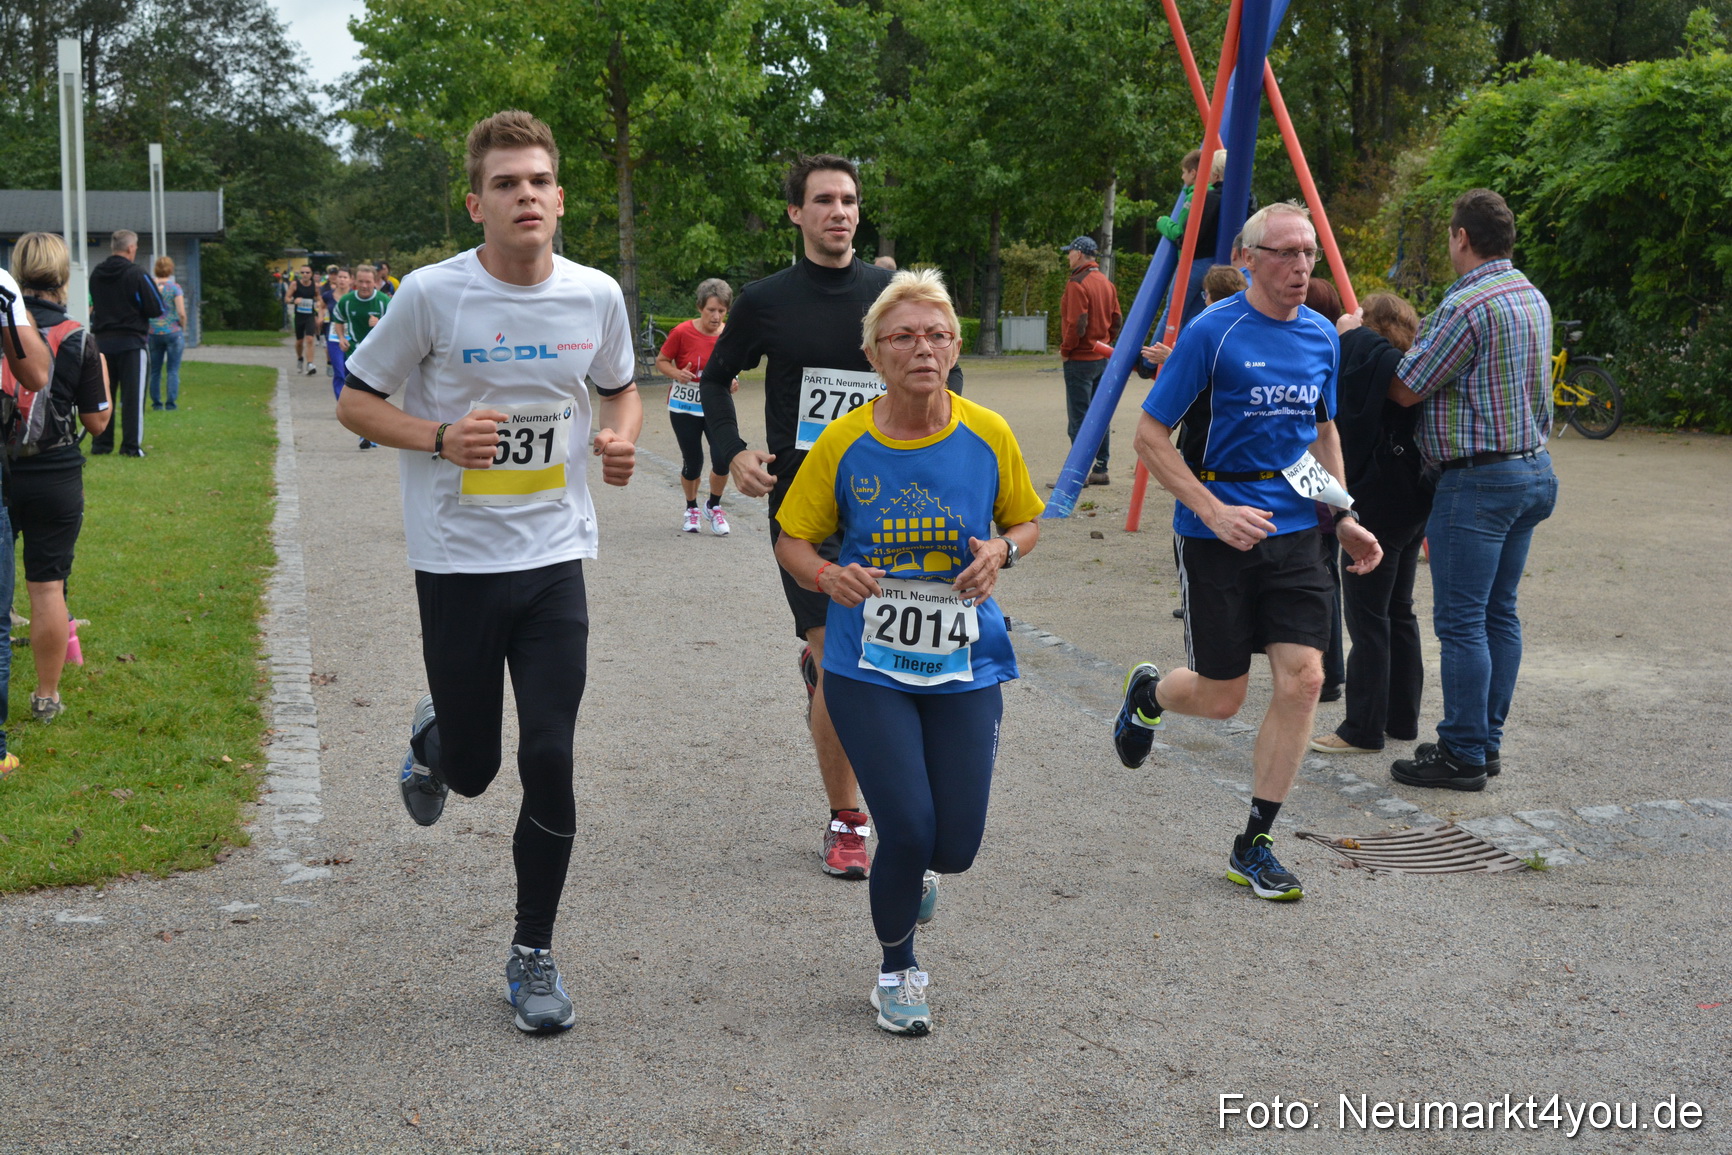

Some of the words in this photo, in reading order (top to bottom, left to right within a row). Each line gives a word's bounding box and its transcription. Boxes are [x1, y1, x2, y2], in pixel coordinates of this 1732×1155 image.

[557, 339, 593, 350] energie
[804, 375, 834, 386] PARTL
[836, 378, 878, 389] Neumarkt
[1250, 385, 1319, 405] SYSCAD
[808, 388, 880, 421] 278
[512, 413, 562, 423] Neumarkt
[881, 588, 908, 600] RTL
[910, 590, 959, 605] Neumarkt
[875, 604, 970, 648] 2014
[893, 653, 943, 674] Theres
